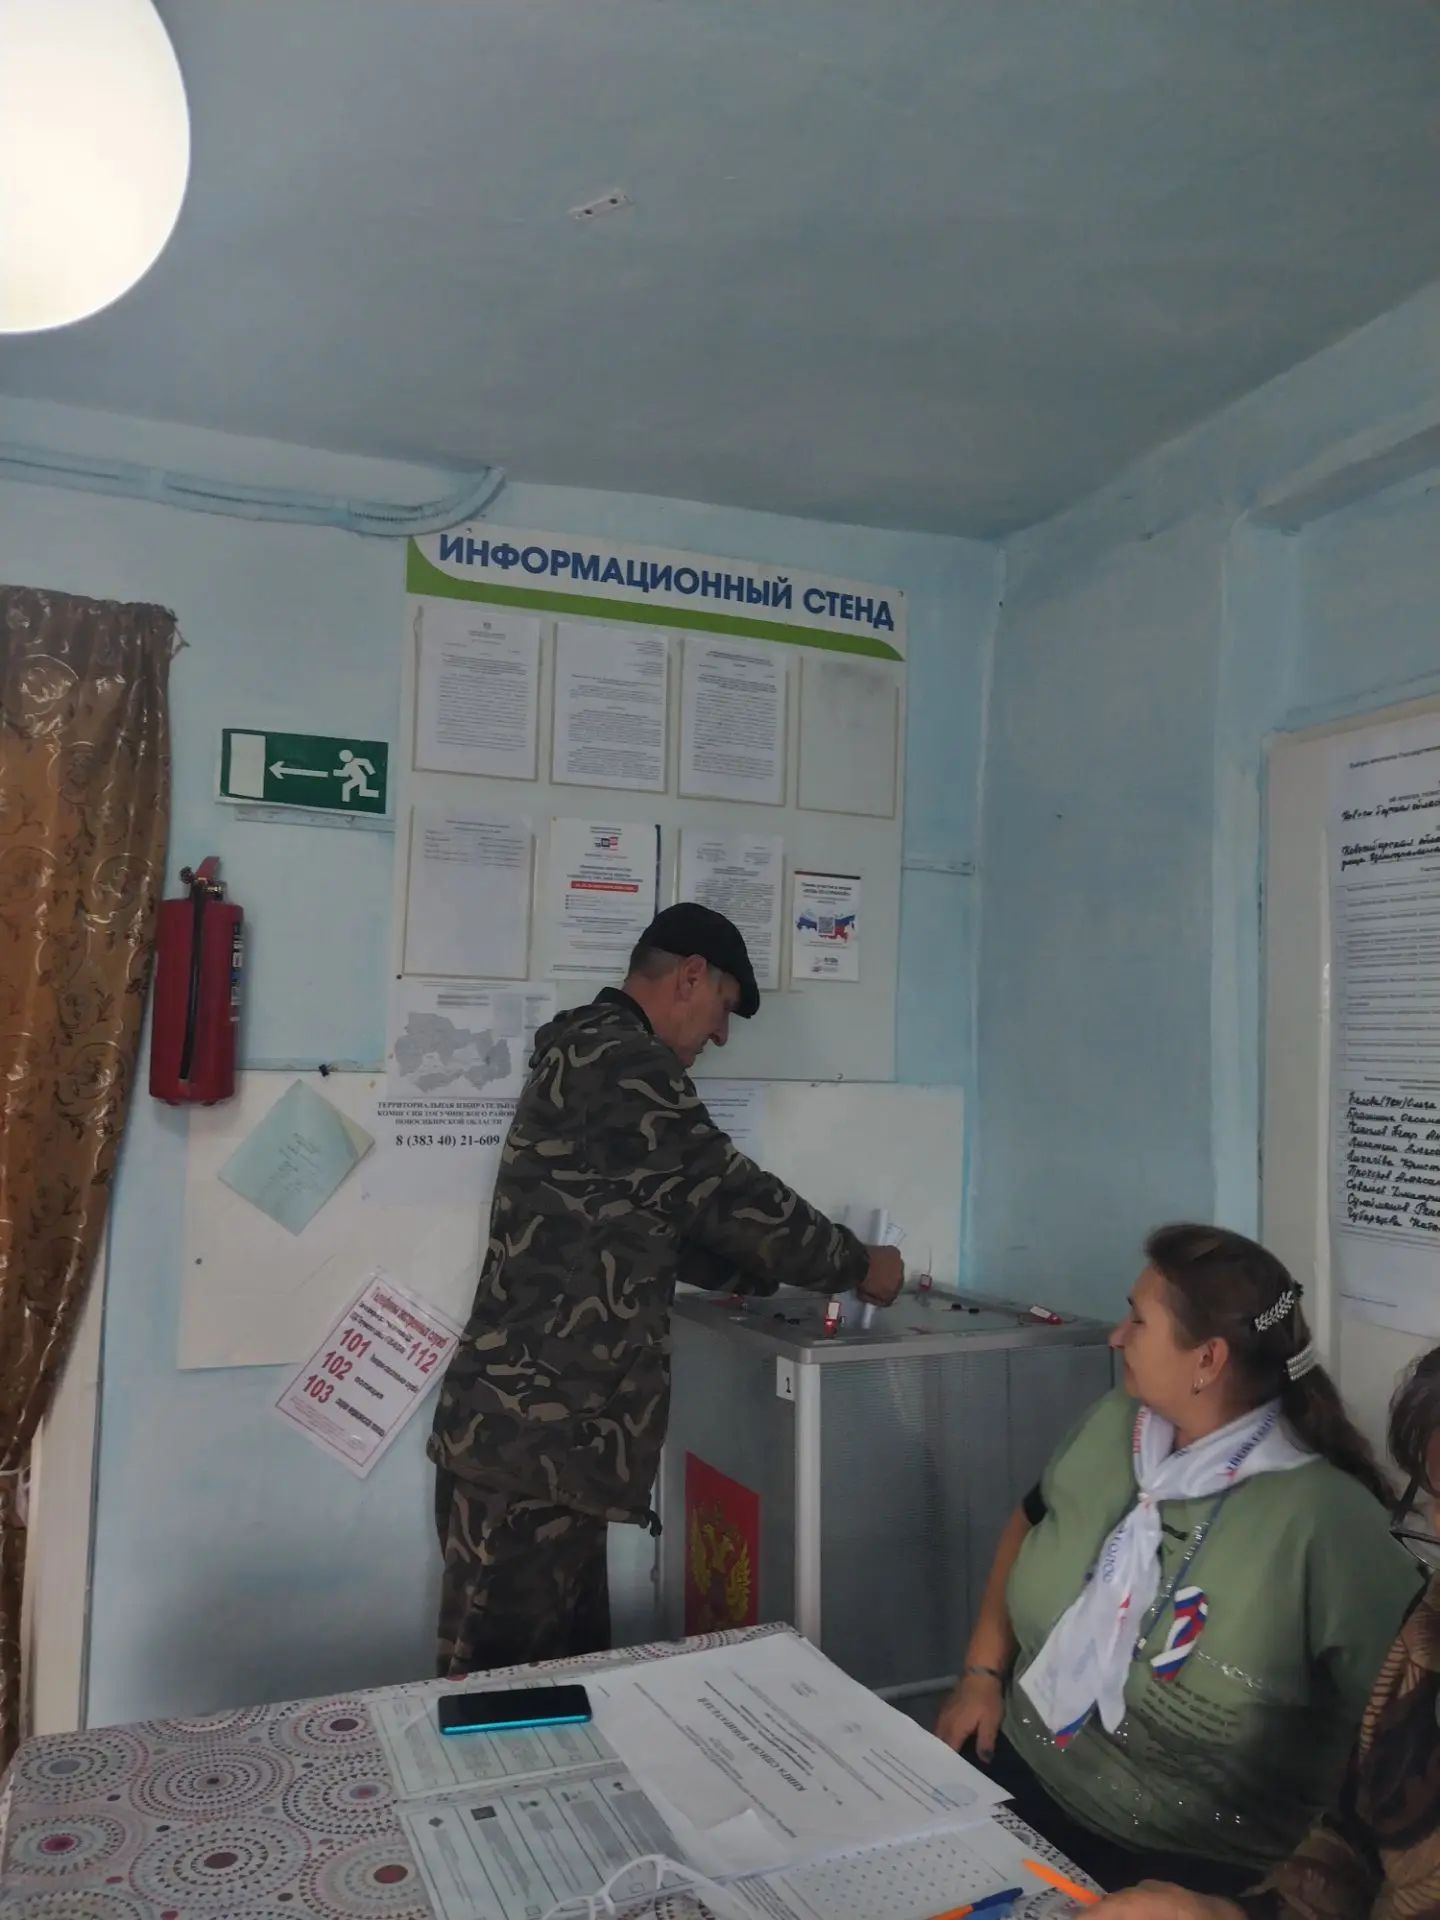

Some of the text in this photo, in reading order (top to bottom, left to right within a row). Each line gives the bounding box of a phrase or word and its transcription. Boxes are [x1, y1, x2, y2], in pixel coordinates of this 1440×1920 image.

[439, 533, 894, 631] ИНФОРМАЦИОННЫЙ СТЕНД
[377, 1101, 518, 1111] ТЕРРИТОРИАЛЬНАЯ ИЗБИРАТЕЛЬНА
[395, 1118, 503, 1126] НОВОСИБИРСКОЙ ОБЛАСТИ
[395, 1134, 501, 1148] 8 (383 40) 21-609
[339, 1328, 372, 1359] 101
[406, 1341, 439, 1374] 112
[321, 1350, 353, 1381] 102
[303, 1374, 335, 1404] 103
[785, 1377, 792, 1393] 1
